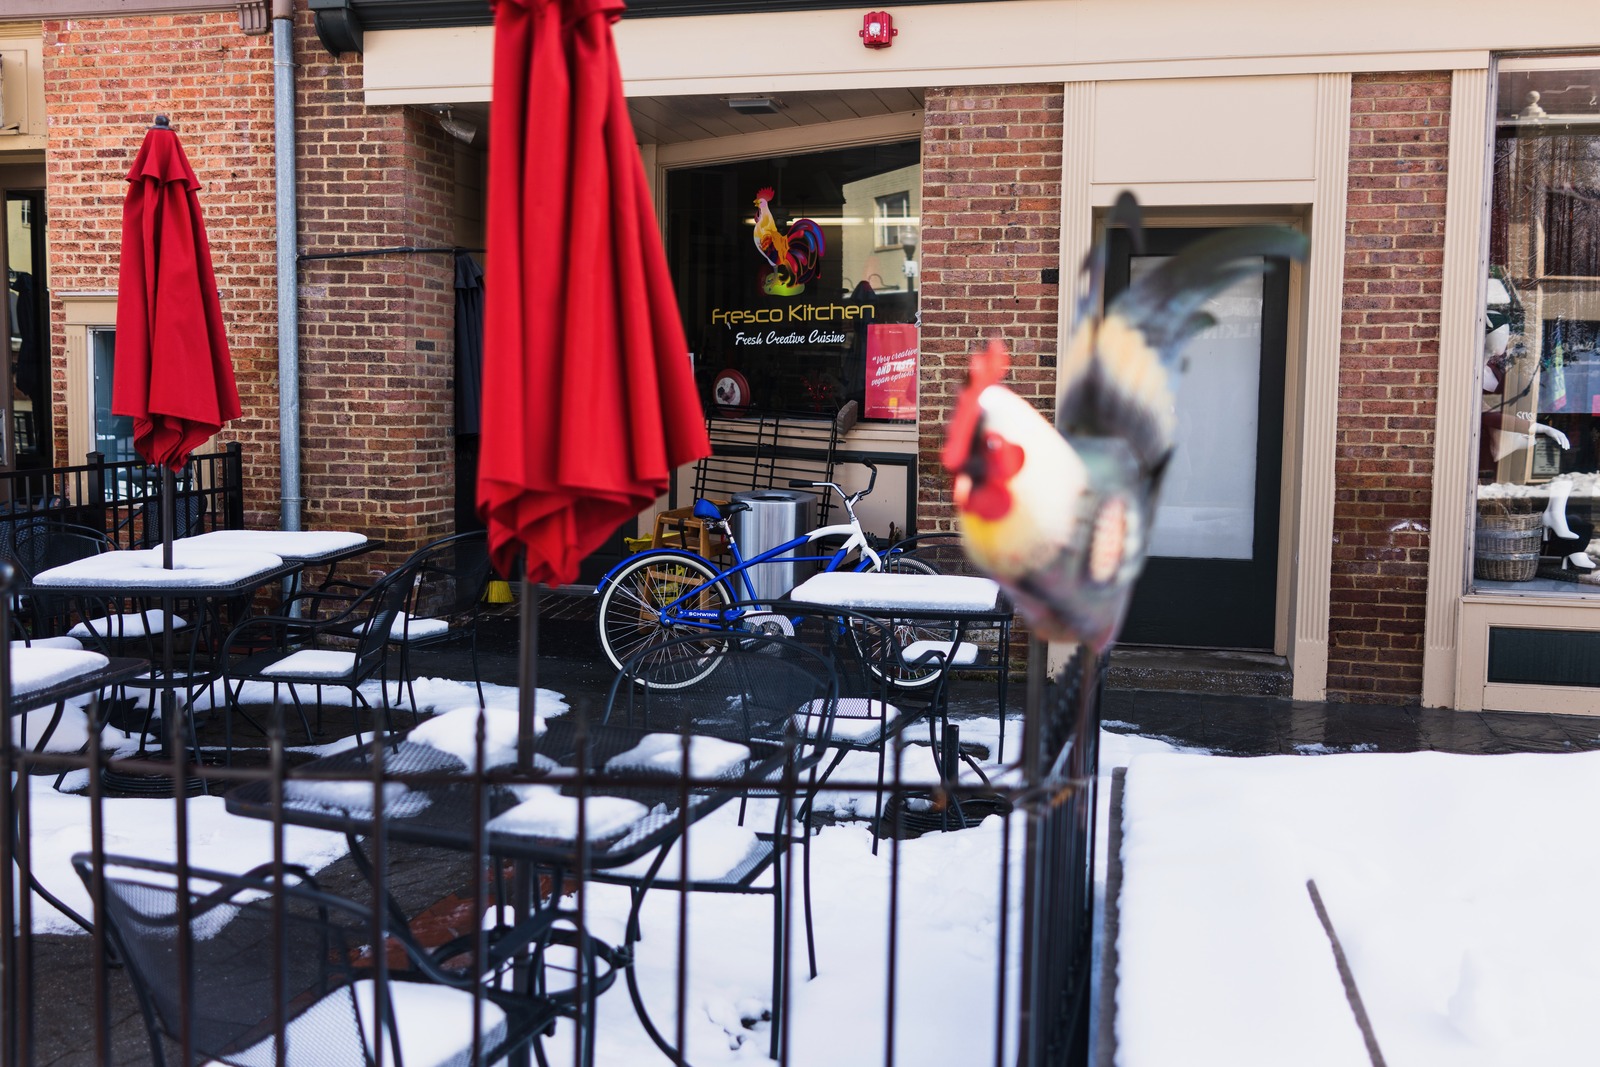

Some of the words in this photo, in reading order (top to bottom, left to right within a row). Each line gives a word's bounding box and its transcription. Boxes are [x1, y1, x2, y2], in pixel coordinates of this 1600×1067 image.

[788, 303, 875, 322] Kitchen
[735, 331, 763, 346] Fresh
[765, 330, 806, 345] Creative
[808, 329, 846, 345] Cuisine
[876, 364, 892, 377] AND
[871, 374, 891, 387] vegan
